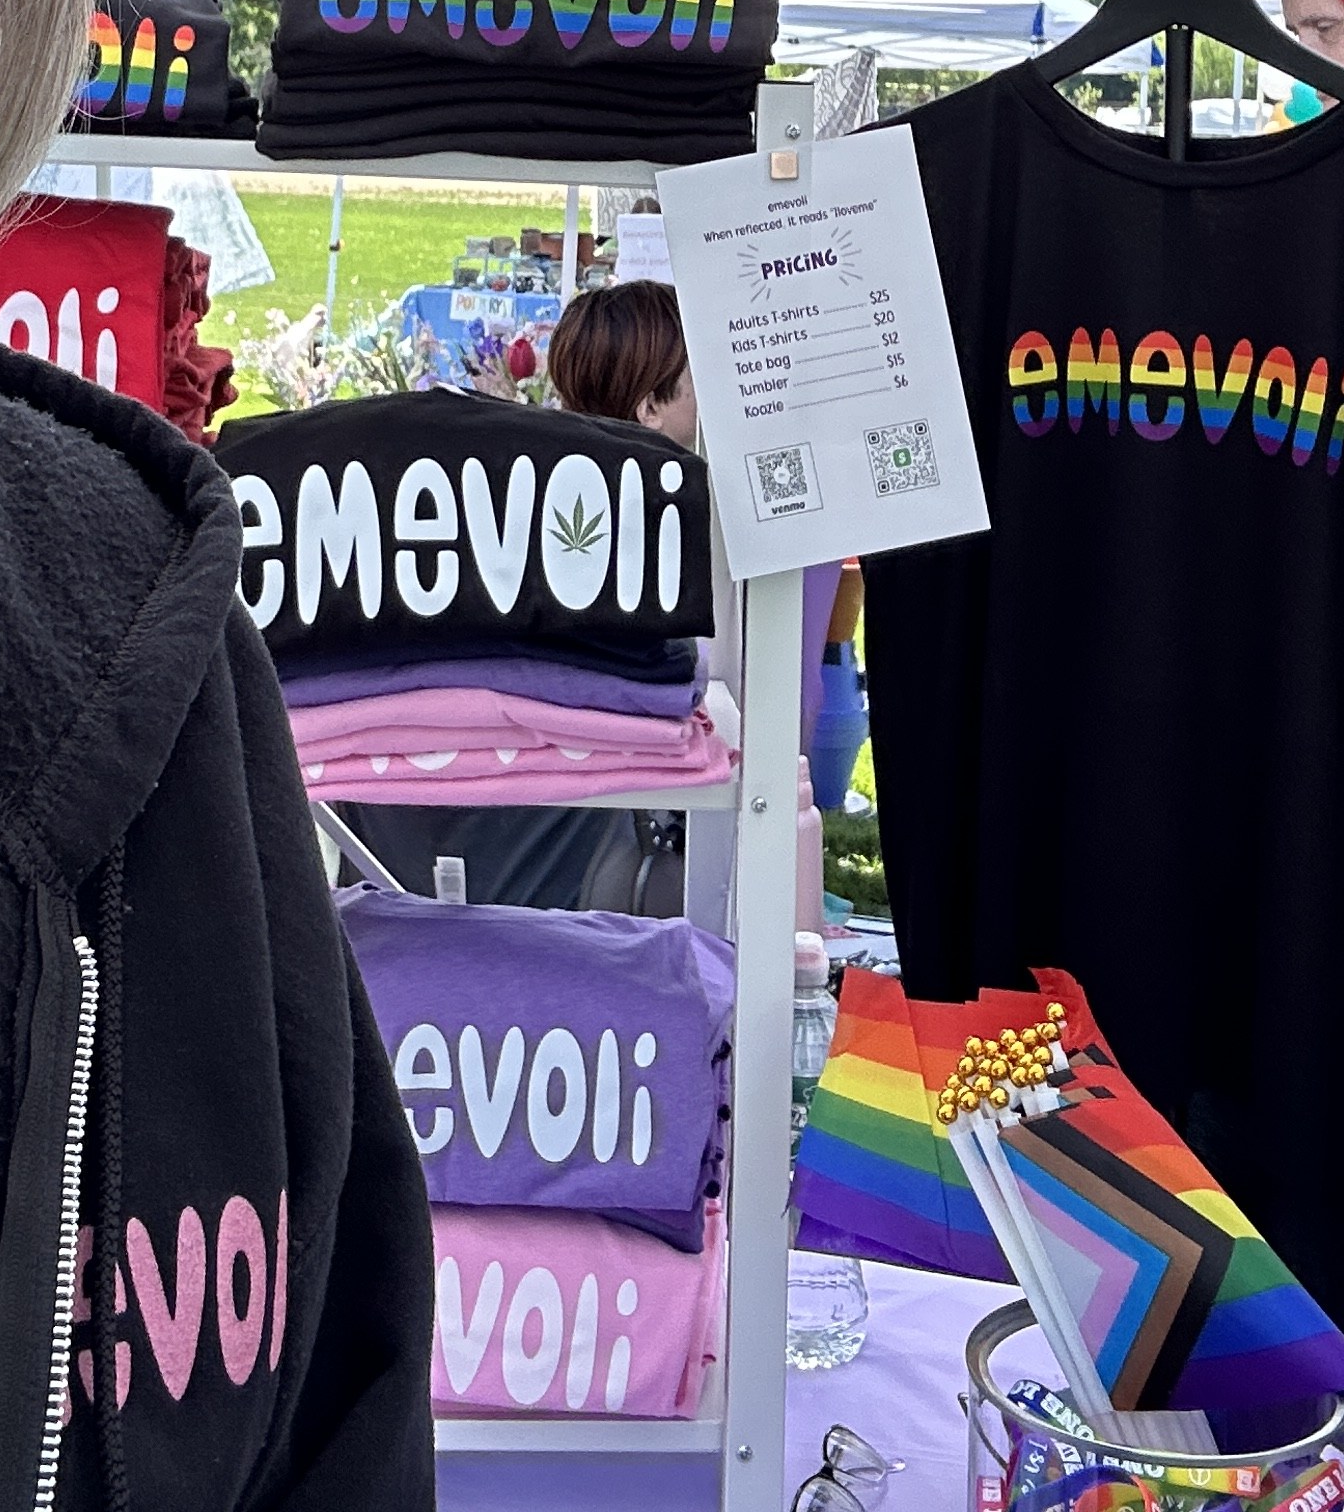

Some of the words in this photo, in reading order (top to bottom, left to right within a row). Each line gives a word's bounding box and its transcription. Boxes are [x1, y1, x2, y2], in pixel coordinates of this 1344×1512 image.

[768, 194, 808, 212] emevoli
[703, 230, 733, 243] When
[788, 216, 797, 227] it
[799, 209, 828, 225] reads
[729, 315, 769, 333] Adults
[771, 305, 819, 324] T-shirts
[869, 289, 890, 305] $25
[731, 338, 757, 354] Kids
[759, 329, 808, 348] T-shirts
[873, 310, 895, 327] $20
[735, 361, 762, 376] Tote
[766, 355, 791, 370] bag
[882, 331, 900, 347] $12
[738, 377, 791, 397] Tumbler
[887, 352, 905, 369] $15
[744, 400, 784, 419] Koozie
[894, 374, 908, 390] $6
[771, 501, 808, 518] venmo
[231, 454, 683, 629] emevoli
[394, 1023, 656, 1165] evoli
